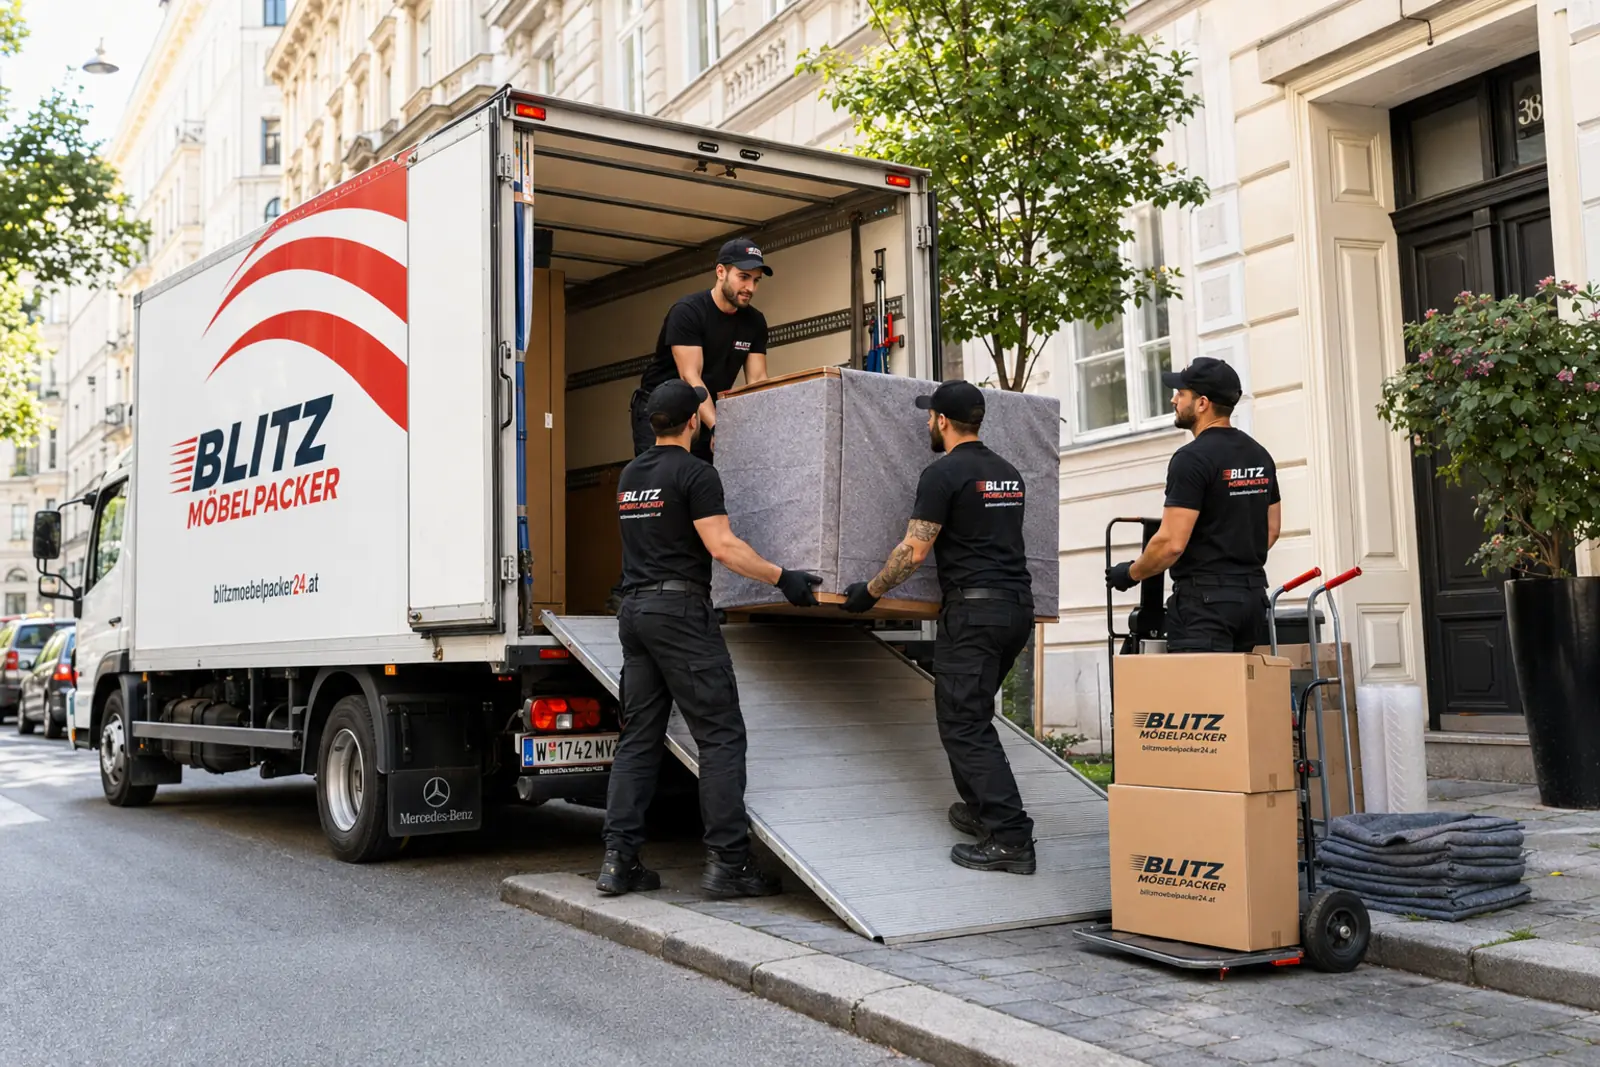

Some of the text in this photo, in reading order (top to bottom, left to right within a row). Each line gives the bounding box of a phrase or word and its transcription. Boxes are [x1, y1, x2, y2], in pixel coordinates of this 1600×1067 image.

[192, 393, 334, 492] BLITZ
[1230, 467, 1264, 479] BLITZ
[622, 488, 661, 502] BLITZ
[985, 481, 1019, 491] BLITZ
[187, 467, 340, 530] MÖBELPACKER
[213, 573, 319, 604] blitzmoebelpacker24.at
[1145, 712, 1224, 731] BLITZ
[1139, 729, 1227, 742] MÖBELPACKER
[536, 742, 547, 761] W
[558, 740, 592, 760] 1742
[400, 809, 473, 824] Mercedes-Benz
[1144, 856, 1224, 880] BLITZ
[1137, 874, 1227, 892] MÖBELPACKER
